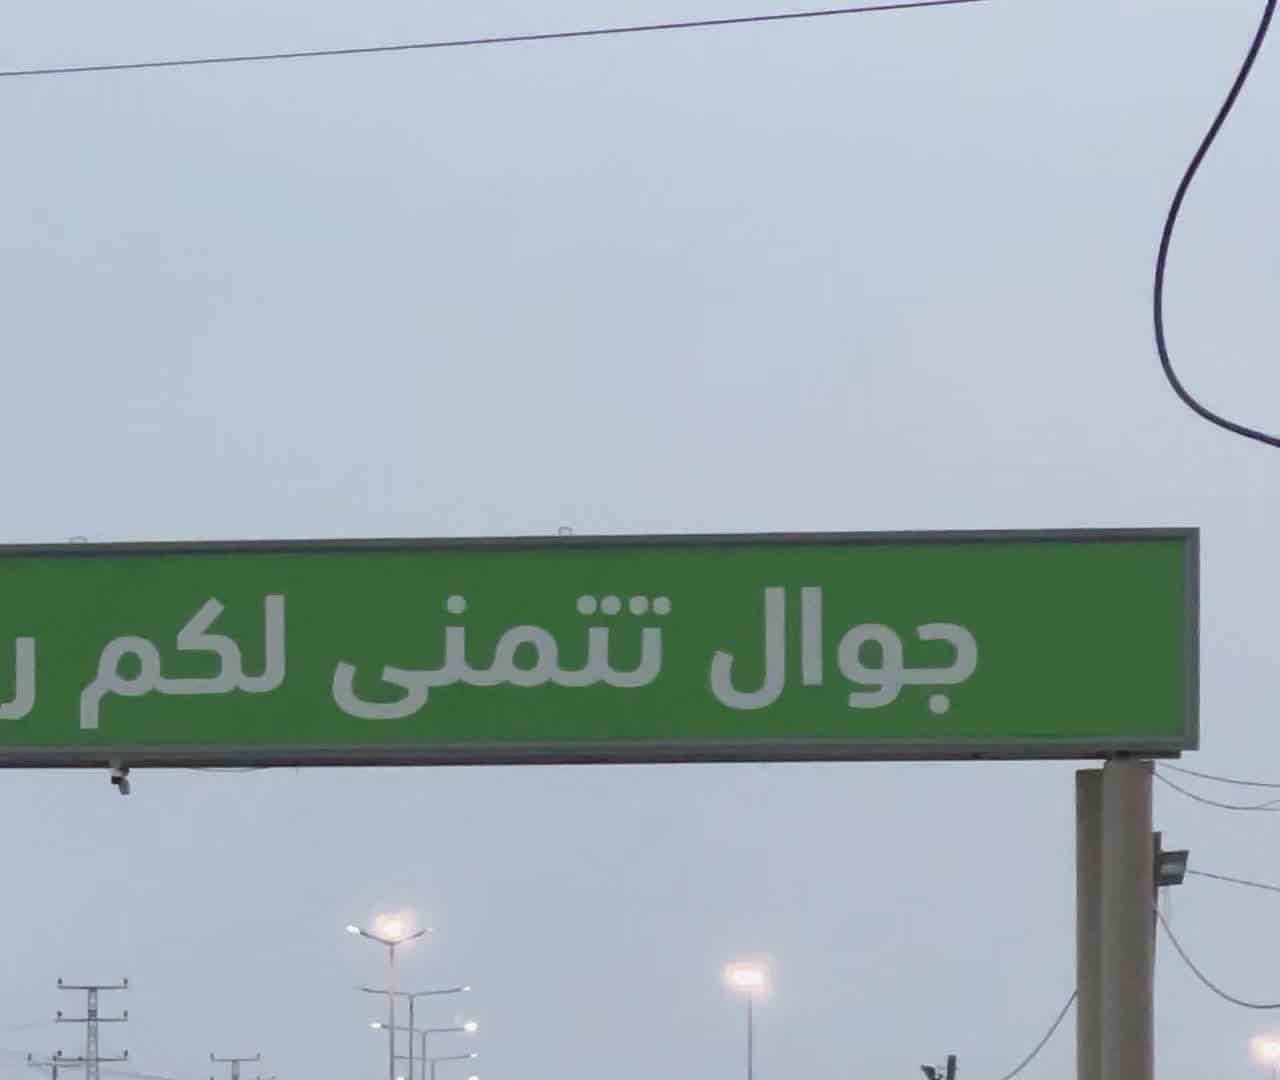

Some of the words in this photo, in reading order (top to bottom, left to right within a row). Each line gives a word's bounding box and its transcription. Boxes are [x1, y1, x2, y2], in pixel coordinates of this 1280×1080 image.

[79, 594, 286, 729] لكم
[332, 595, 671, 720] تتمنى
[710, 586, 977, 714] جوال
